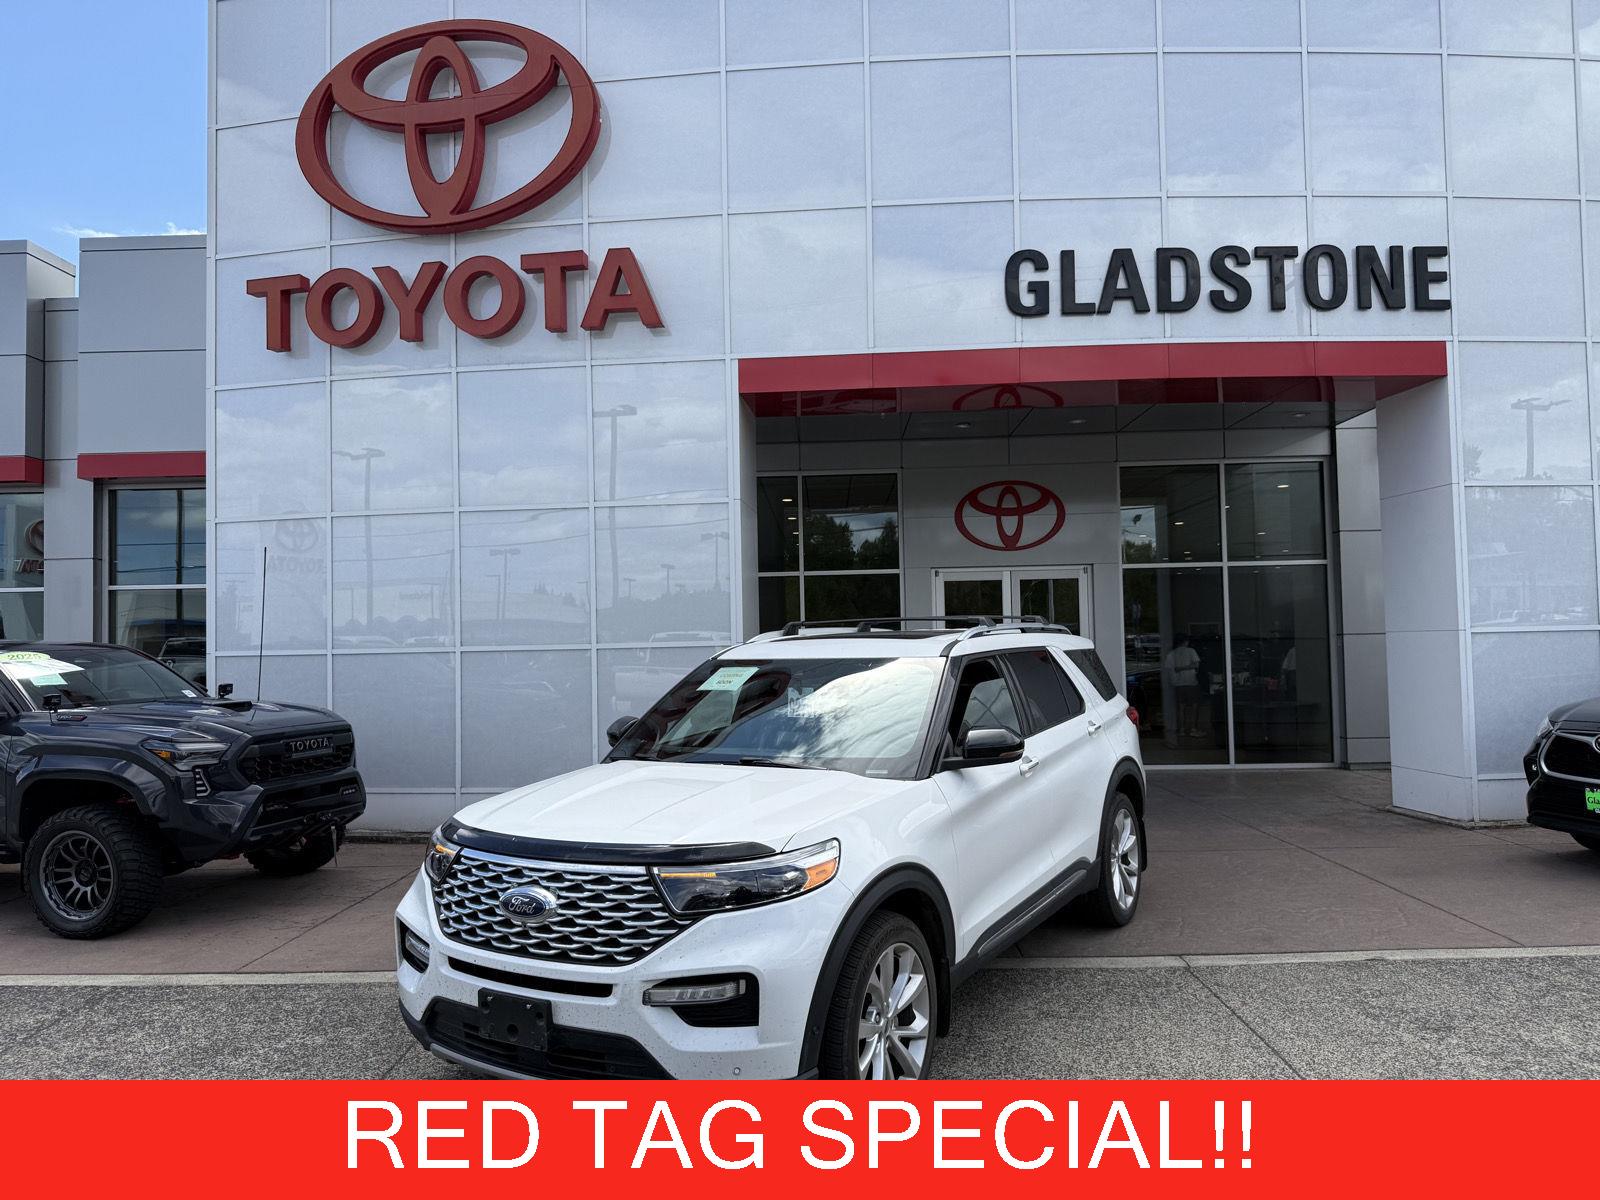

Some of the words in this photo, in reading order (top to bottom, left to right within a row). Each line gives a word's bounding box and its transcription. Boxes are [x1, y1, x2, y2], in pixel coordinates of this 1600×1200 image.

[246, 247, 664, 352] TOYOTA
[1004, 244, 1452, 318] GLADSTONE
[289, 737, 329, 751] TOYOTA
[508, 896, 536, 914] Ford
